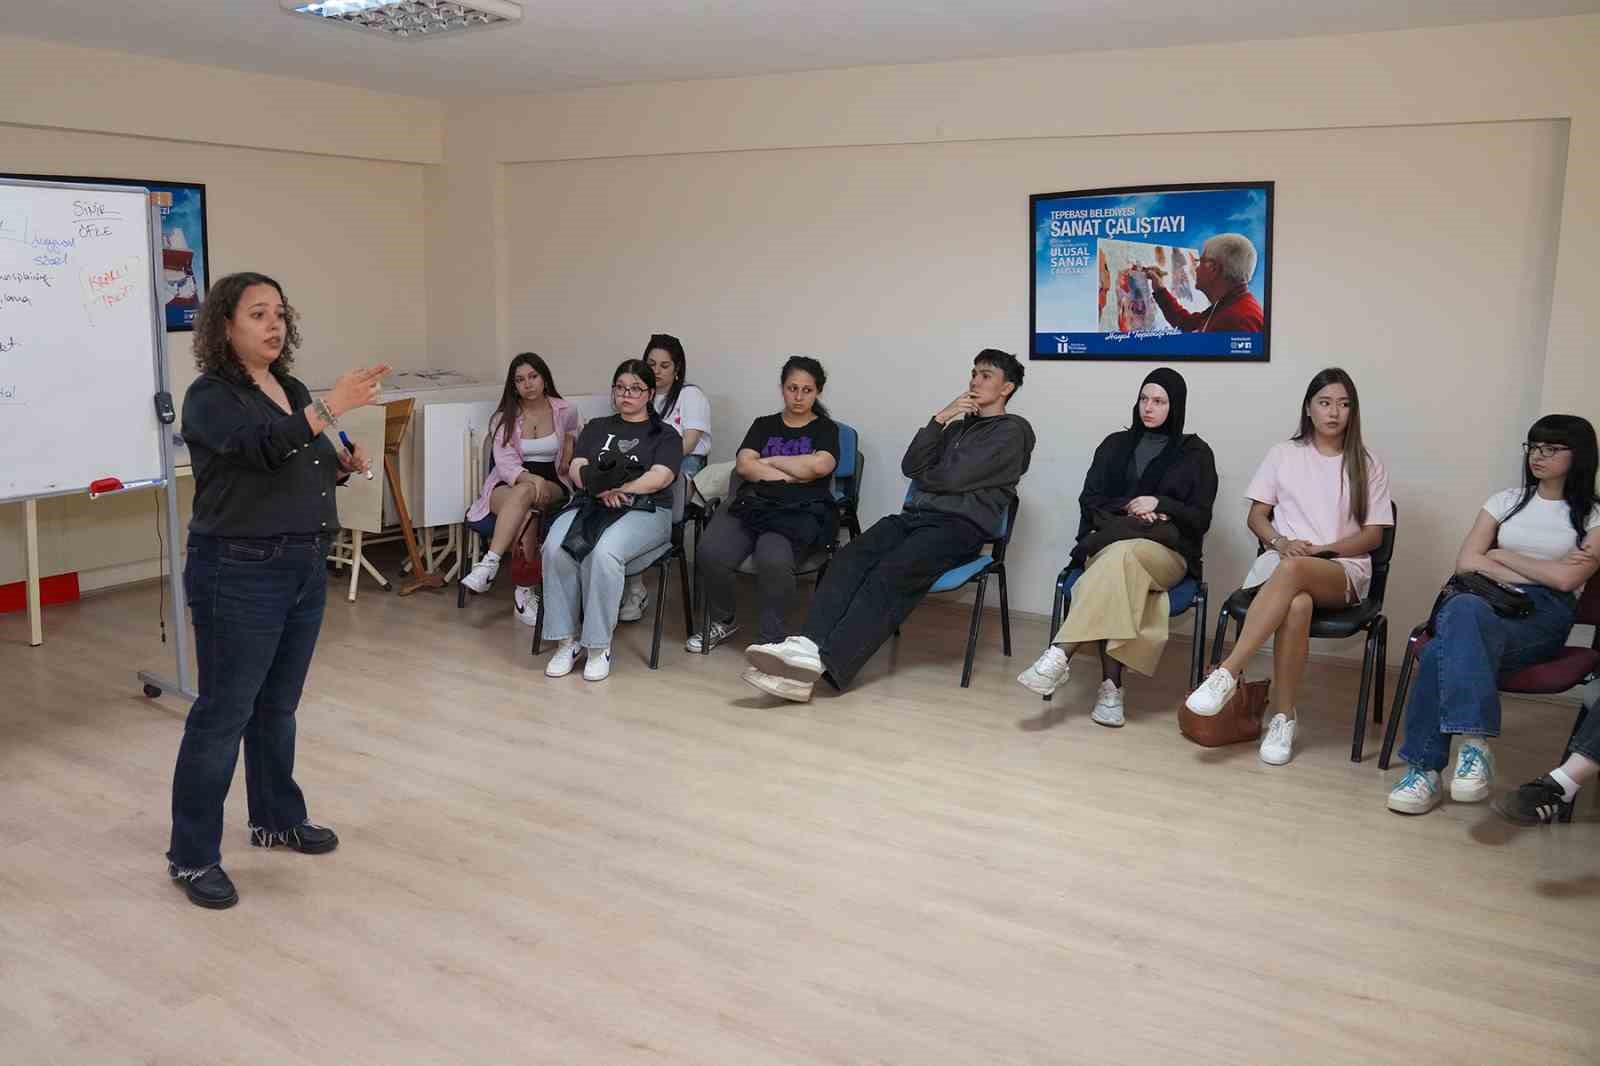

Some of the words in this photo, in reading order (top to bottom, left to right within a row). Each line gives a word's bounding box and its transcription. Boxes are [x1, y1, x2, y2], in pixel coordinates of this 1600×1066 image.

[1050, 209, 1088, 221] TEPEBAŞI
[1050, 219, 1102, 237] SANAT
[1105, 215, 1185, 239] ÇALIŞTAYI
[1050, 247, 1090, 257] ULUSAL
[1050, 257, 1089, 267] SANAT
[601, 433, 616, 451] I
